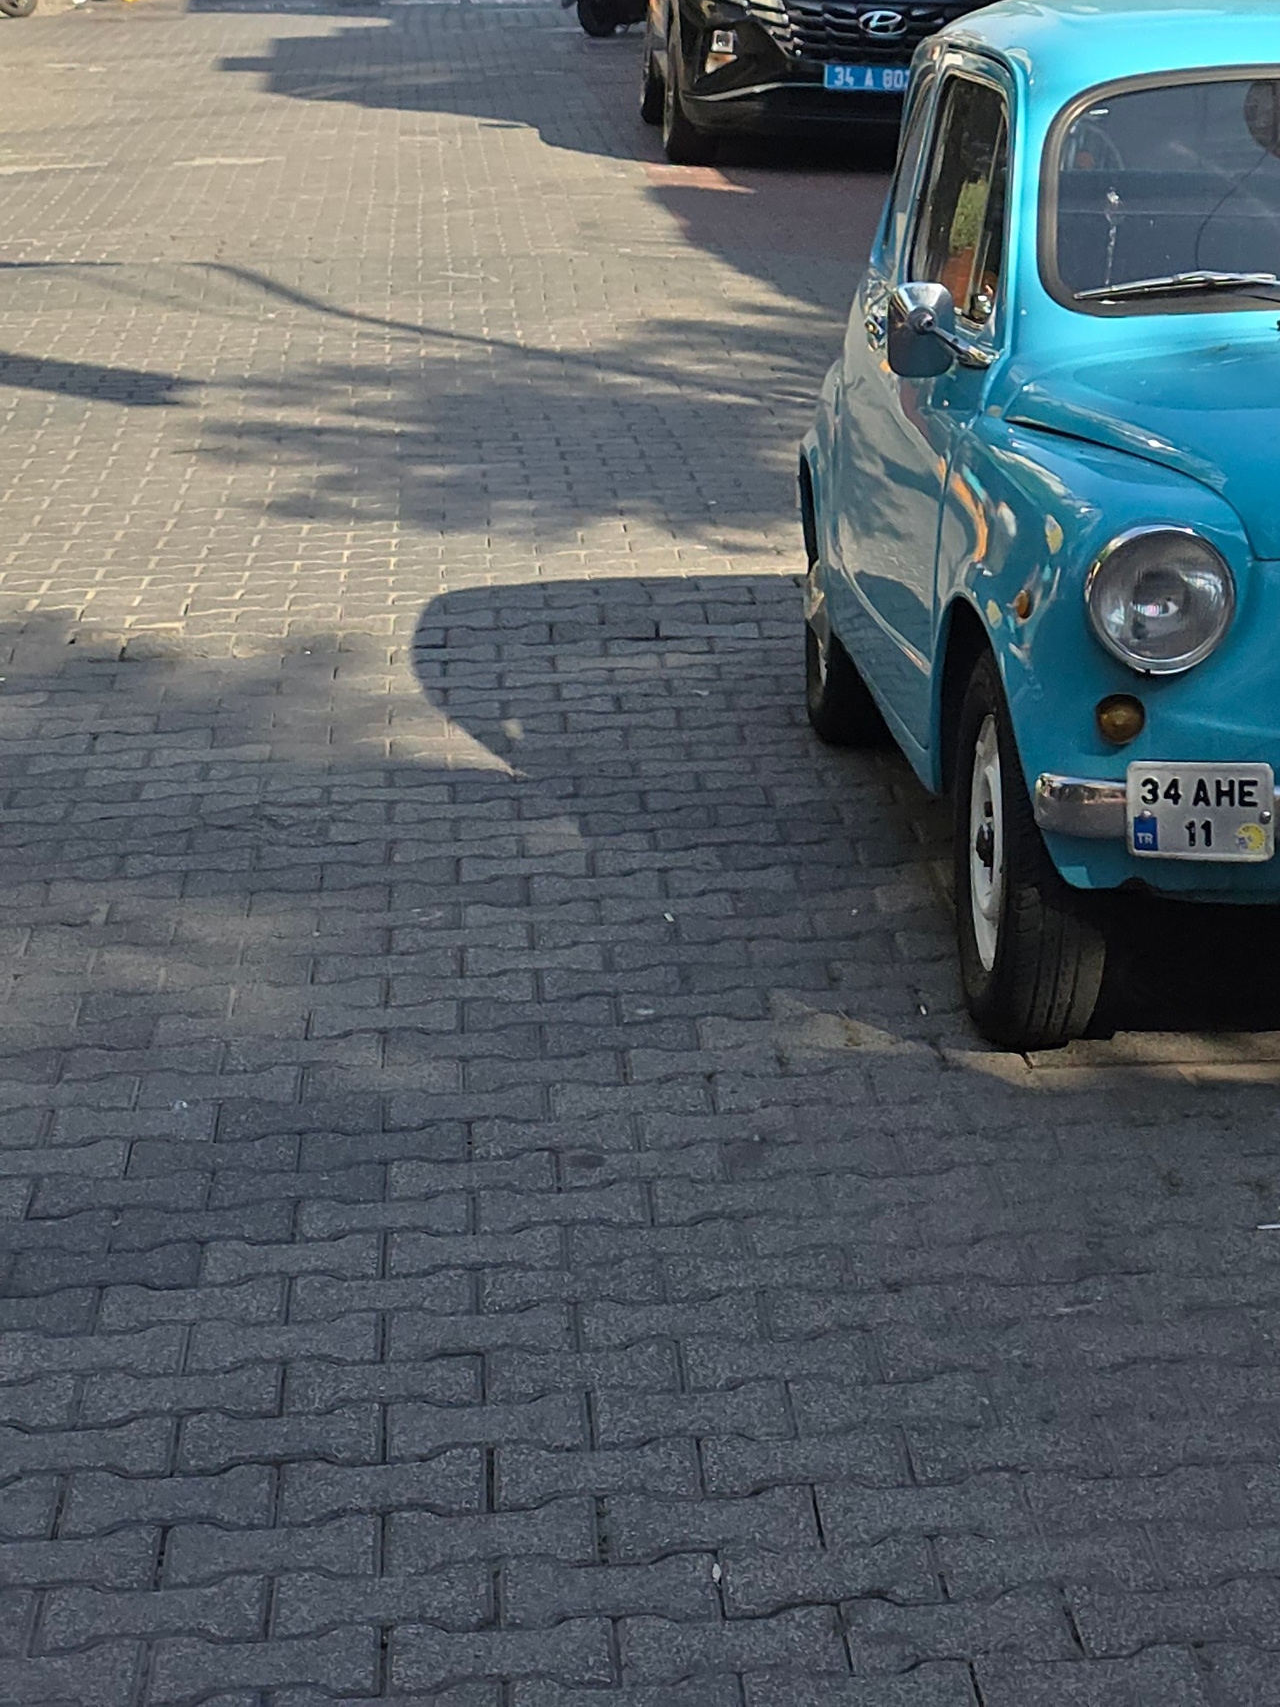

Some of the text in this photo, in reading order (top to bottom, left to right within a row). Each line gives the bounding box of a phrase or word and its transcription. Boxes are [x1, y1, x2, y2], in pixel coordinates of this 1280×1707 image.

[834, 68, 855, 87] 34
[864, 70, 874, 87] A
[1141, 778, 1259, 807] 34 AHE
[1137, 832, 1153, 844] TR
[1185, 820, 1212, 847] 11
